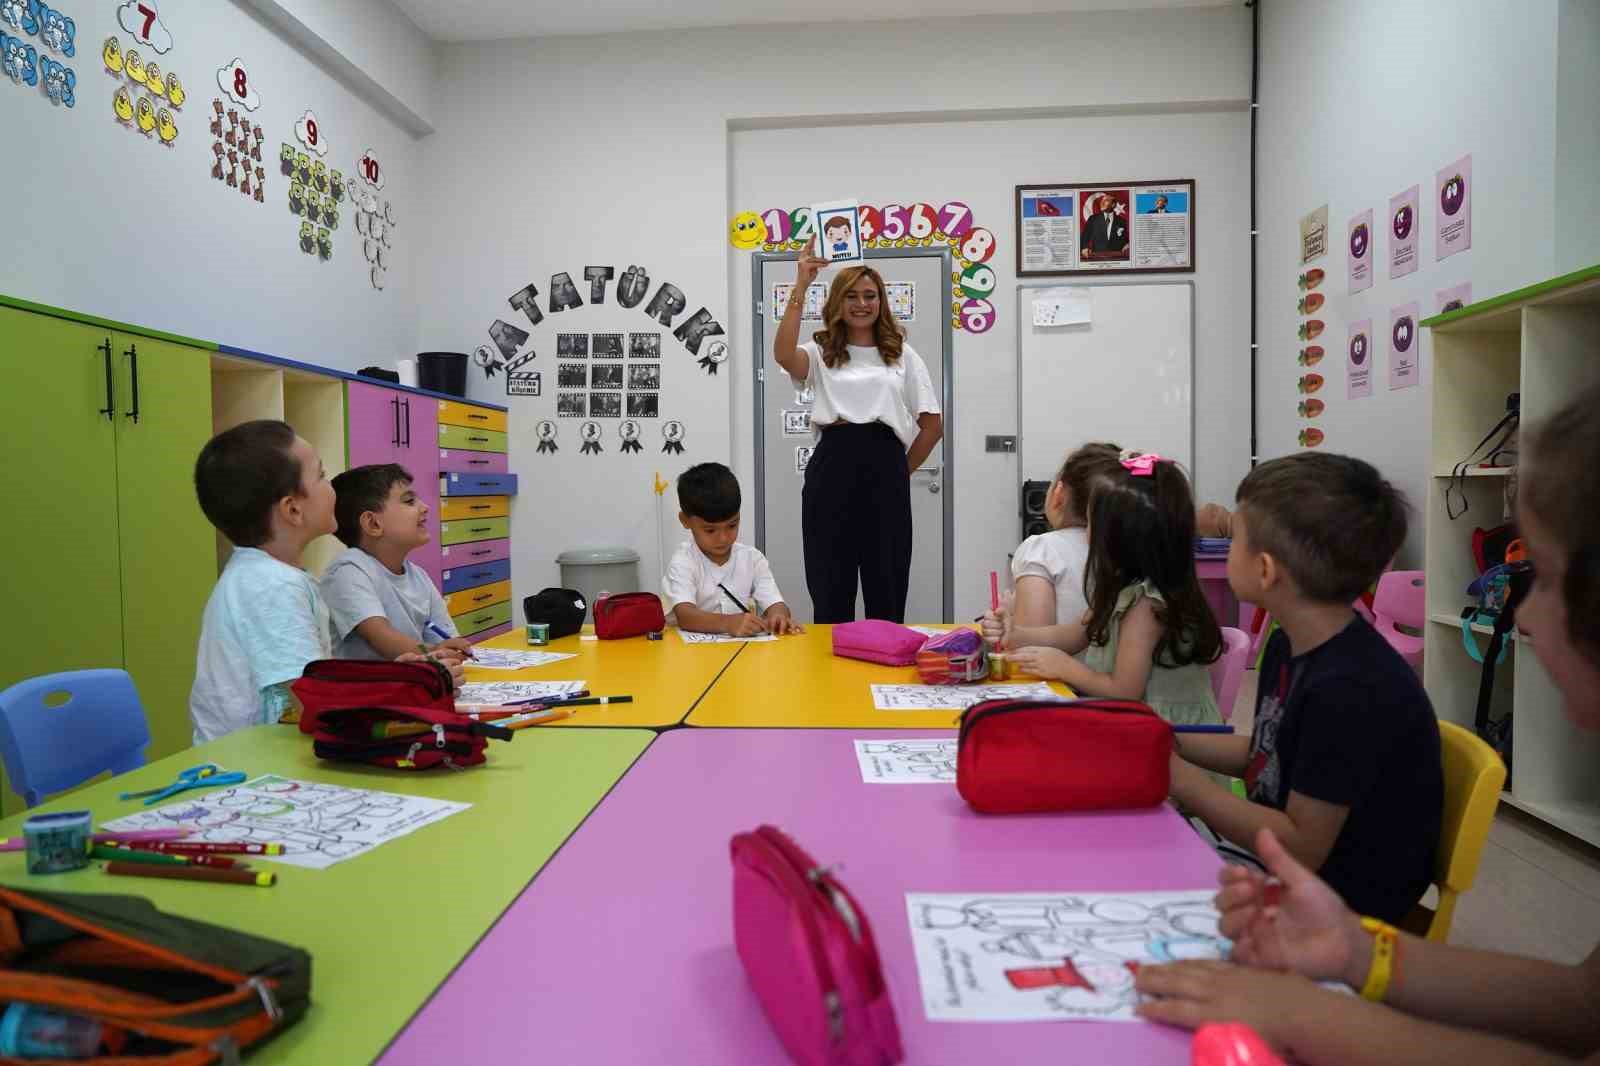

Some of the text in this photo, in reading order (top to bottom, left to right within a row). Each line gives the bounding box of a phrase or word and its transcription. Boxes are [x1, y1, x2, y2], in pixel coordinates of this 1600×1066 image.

[137, 3, 156, 41] 7
[233, 67, 247, 98] 8
[306, 123, 318, 146] 9
[362, 155, 379, 182] 10
[764, 209, 781, 242] 1
[794, 209, 813, 241] 2
[859, 205, 874, 240] 4
[882, 204, 905, 239] 5
[910, 203, 931, 239] 6
[940, 204, 967, 236] 7
[963, 230, 988, 263] 8
[960, 268, 995, 293] 9
[488, 264, 725, 360] ATATÜRK
[961, 299, 993, 331] 10
